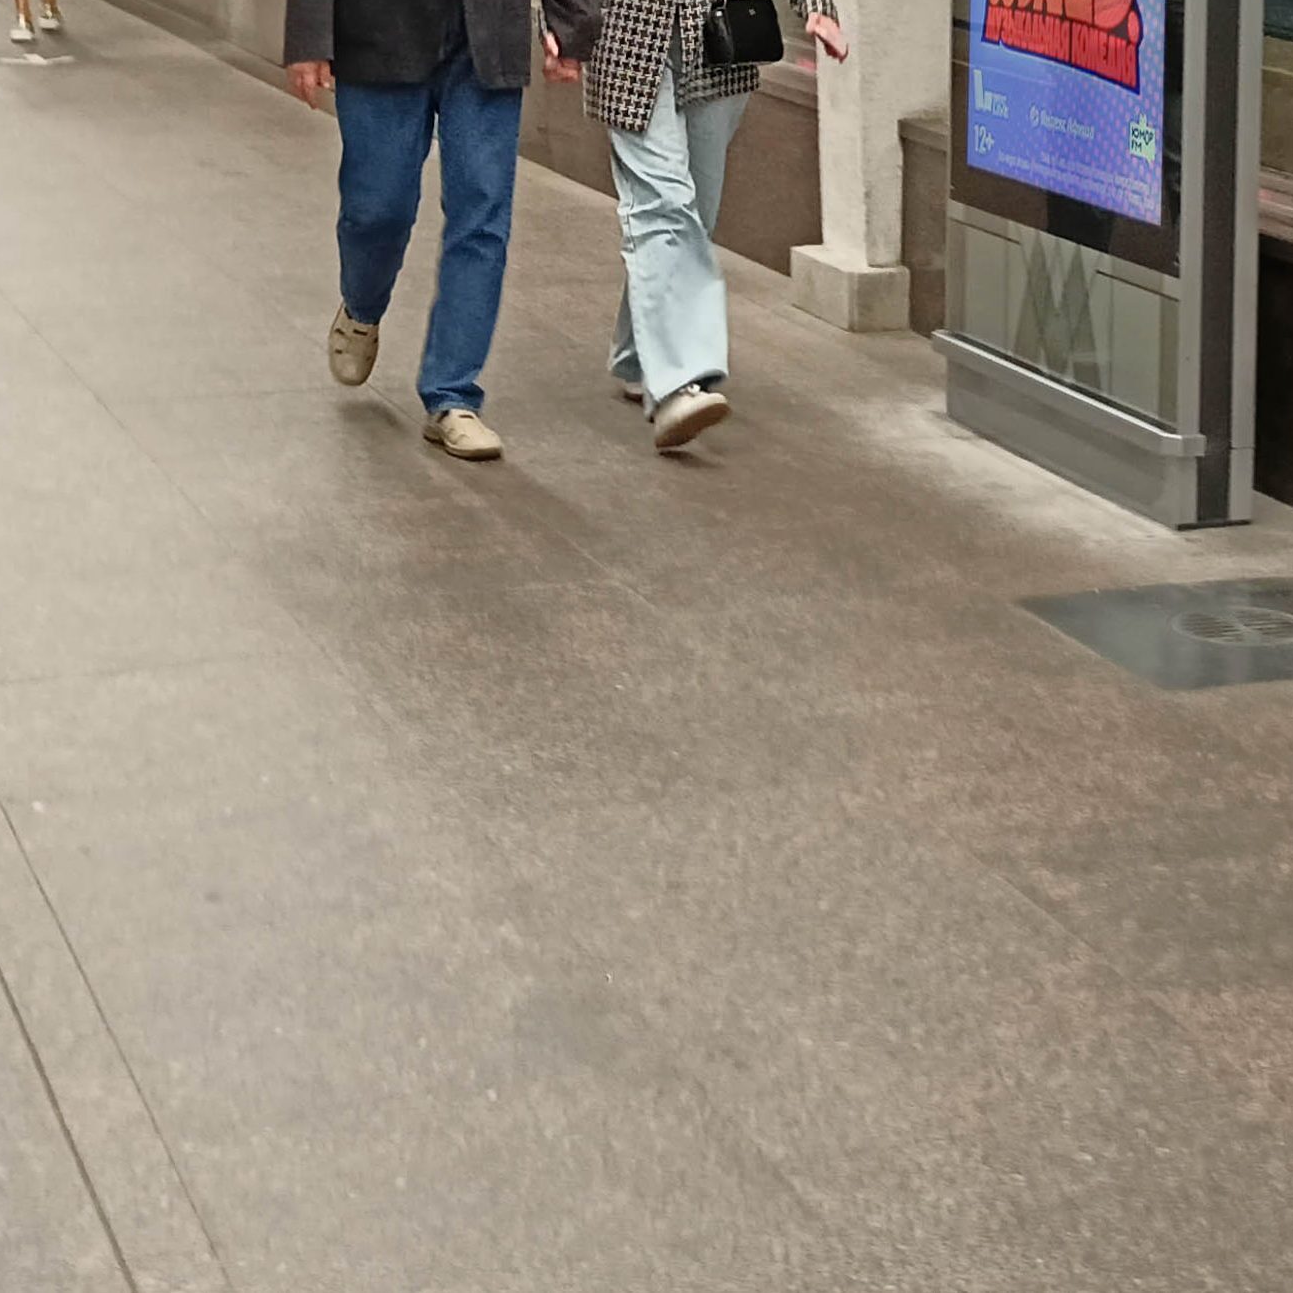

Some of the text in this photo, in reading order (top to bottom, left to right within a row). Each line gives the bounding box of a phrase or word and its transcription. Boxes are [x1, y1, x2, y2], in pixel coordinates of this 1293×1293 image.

[1071, 19, 1137, 88] КОМЕДИЯ
[974, 124, 995, 155] 12+
[1131, 129, 1154, 146] ЮМОР
